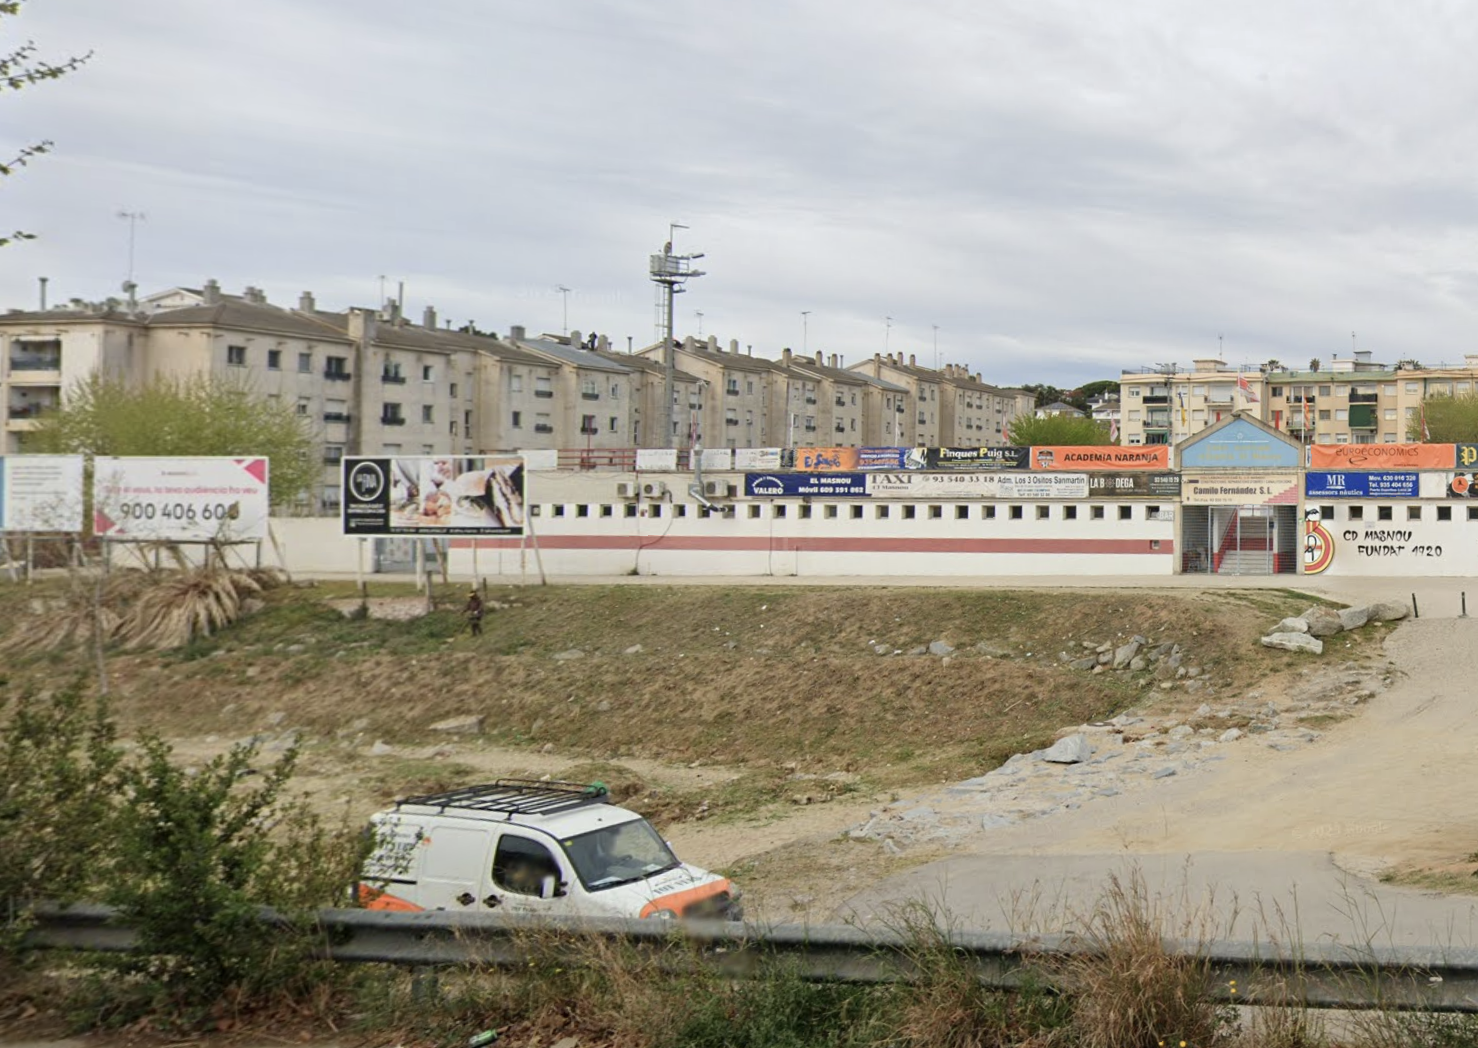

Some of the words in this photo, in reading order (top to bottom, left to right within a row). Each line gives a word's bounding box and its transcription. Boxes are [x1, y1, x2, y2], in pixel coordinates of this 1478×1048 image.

[940, 447, 978, 459] Finques
[980, 447, 1003, 459] Puig
[1064, 453, 1112, 462] ACADEMIA
[1115, 453, 1159, 463] NARANJA
[870, 474, 913, 484] TAXI
[1015, 476, 1026, 484] Los
[1027, 476, 1031, 484] 3
[1089, 477, 1099, 489] LA
[1326, 474, 1346, 486] MR
[753, 487, 784, 495] VALERO
[1193, 486, 1219, 495] Camilo
[1220, 486, 1257, 495] Fernández
[1259, 486, 1266, 495] S.
[1267, 486, 1273, 495] L.
[120, 502, 156, 520] 900
[161, 502, 197, 520] 406
[1159, 511, 1174, 520] BAR
[1343, 530, 1358, 541] CD
[1364, 530, 1412, 542] MASNOU
[1357, 545, 1405, 557] FUNDAT
[1412, 545, 1443, 557] 1920
